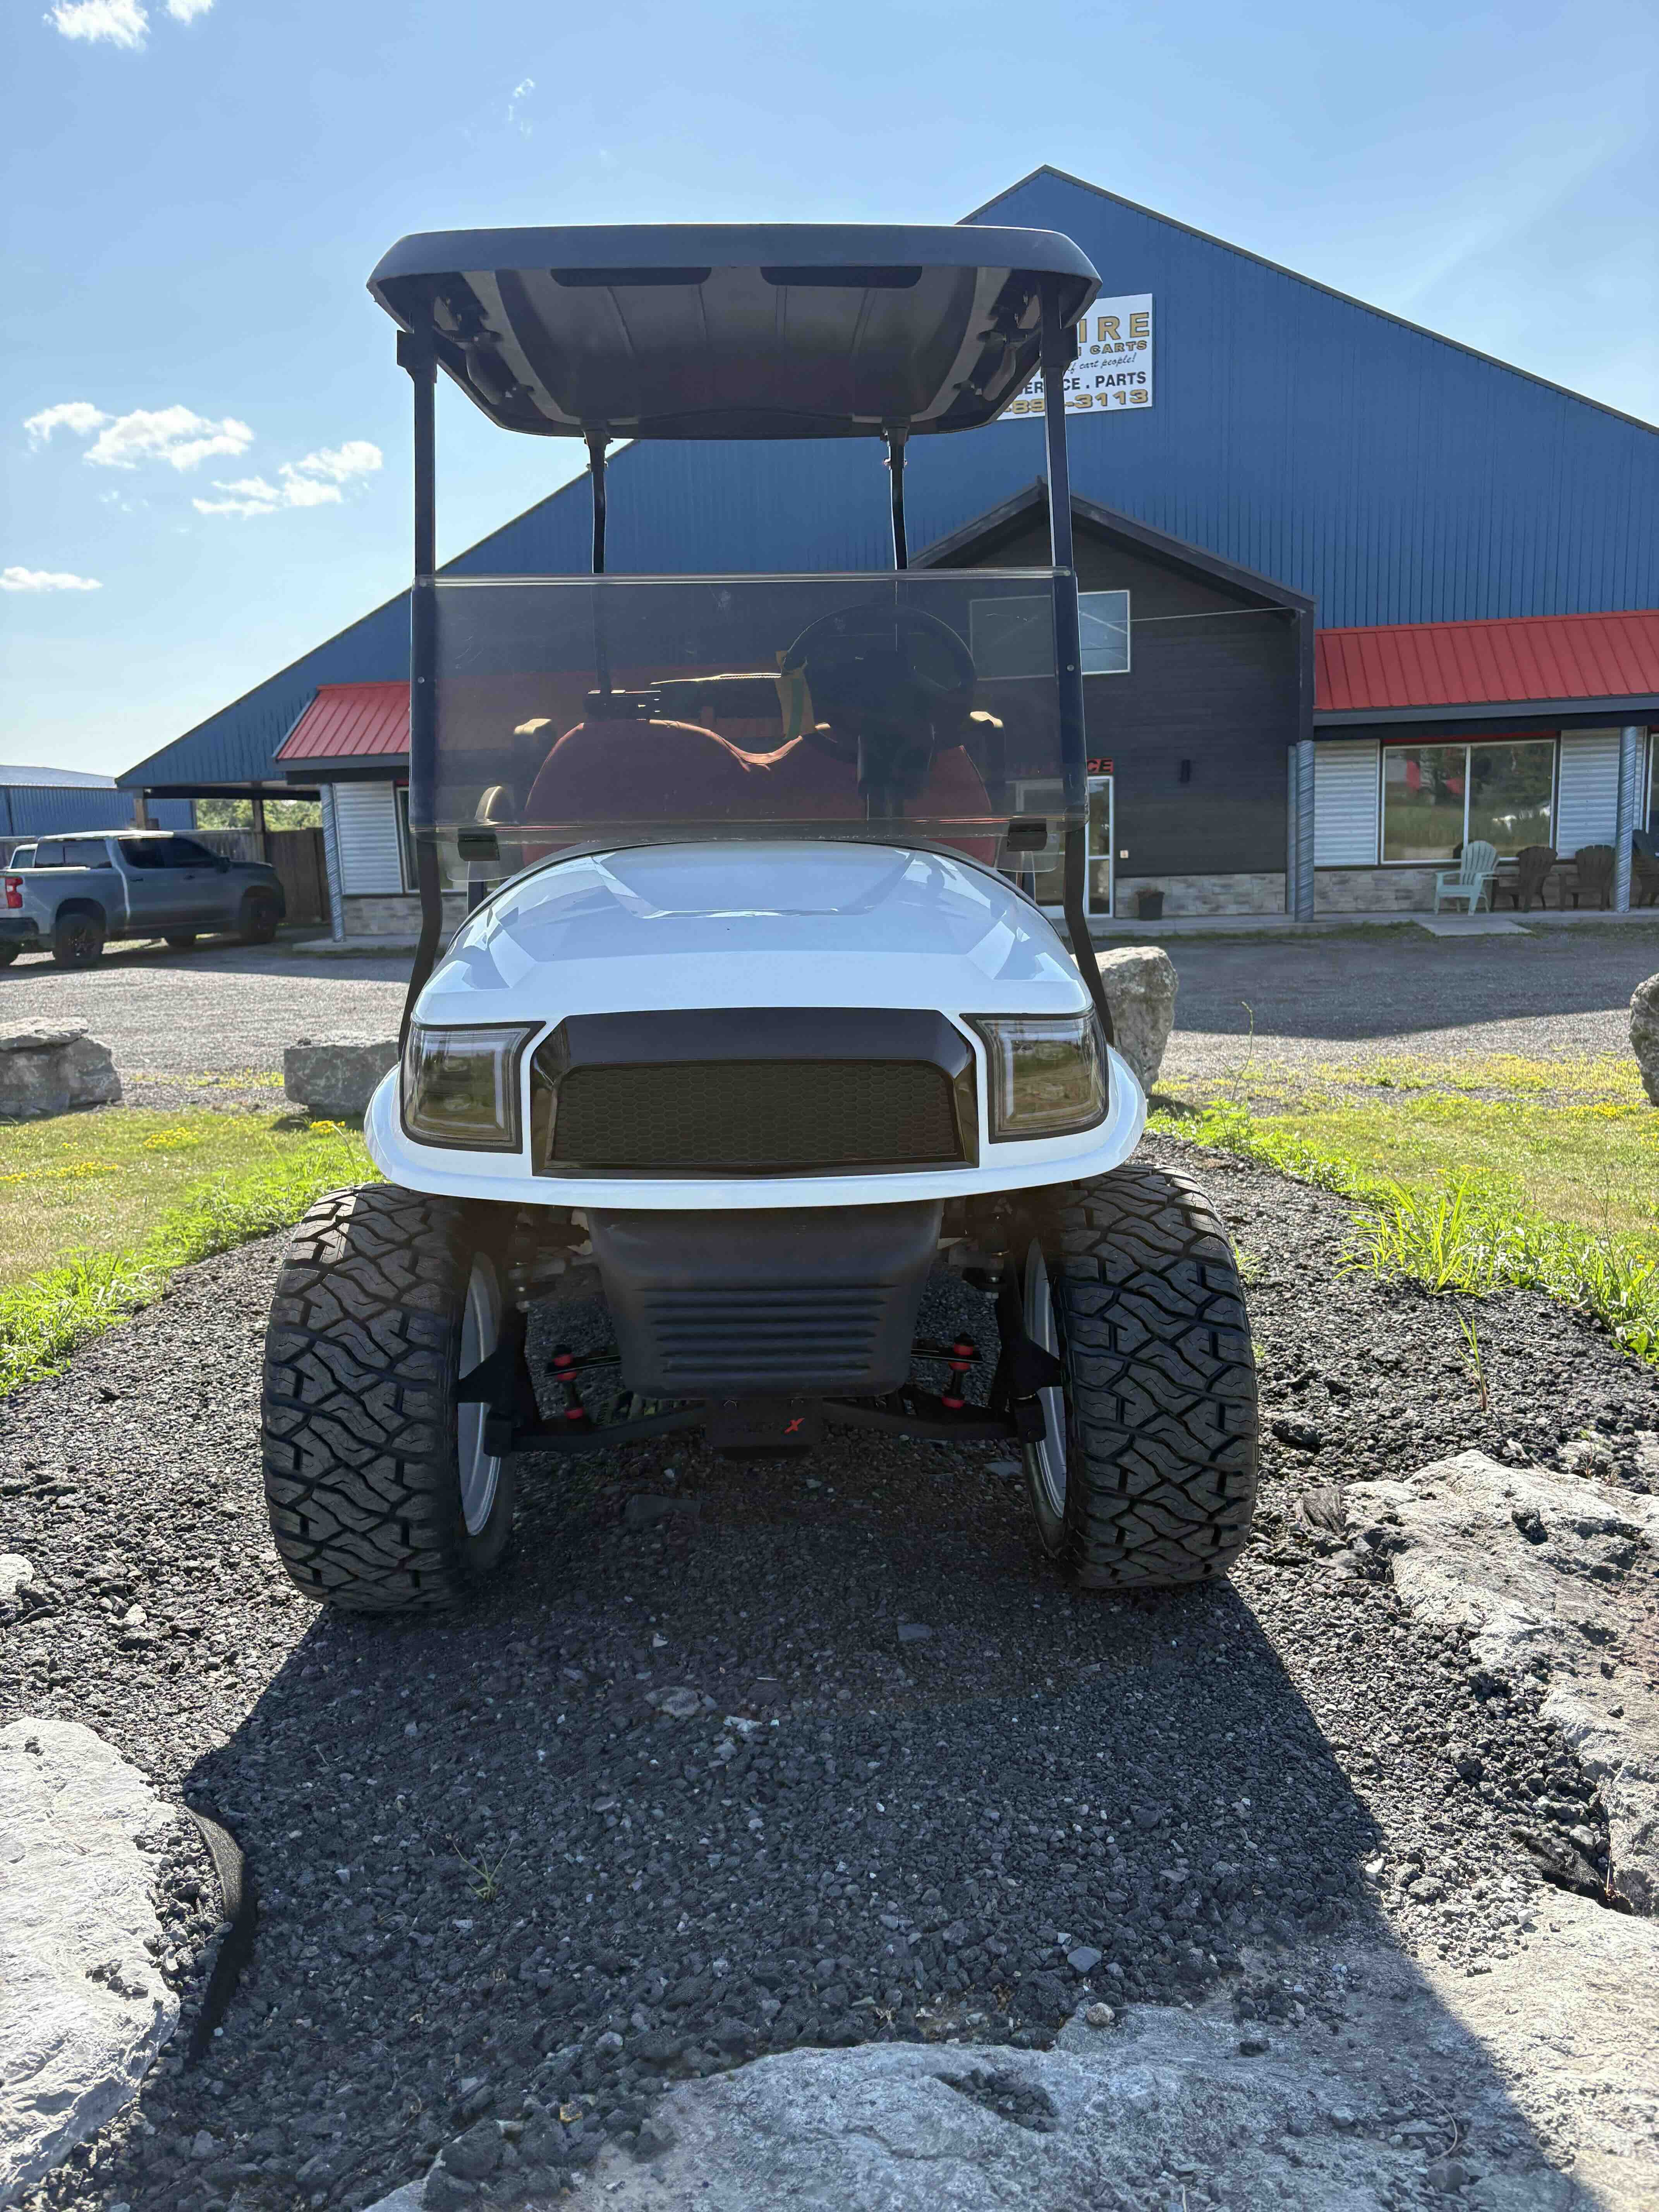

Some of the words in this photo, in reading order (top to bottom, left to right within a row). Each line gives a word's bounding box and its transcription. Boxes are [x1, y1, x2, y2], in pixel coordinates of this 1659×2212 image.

[1079, 312, 1149, 343] IRE
[1090, 340, 1147, 354] CARTS
[1080, 361, 1099, 369] cart
[1101, 352, 1137, 368] people!
[1025, 378, 1080, 394] ERCE
[1095, 371, 1146, 388] PARTS
